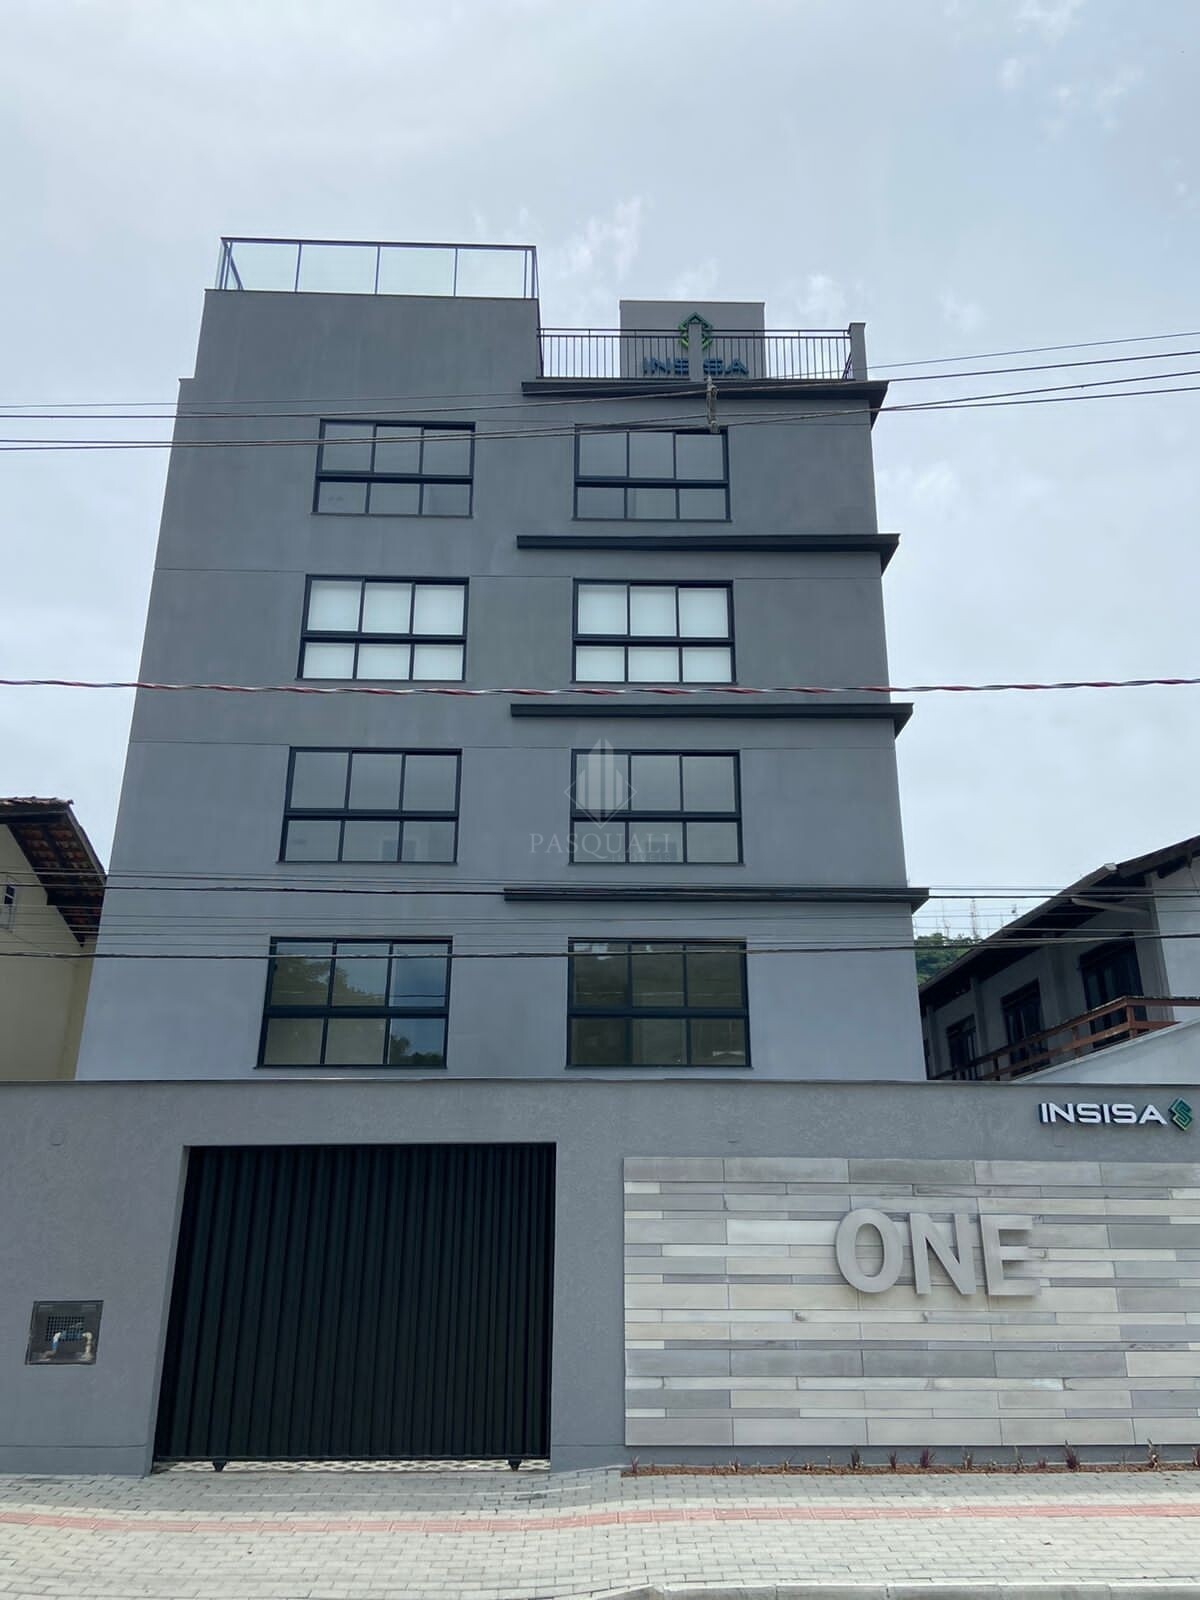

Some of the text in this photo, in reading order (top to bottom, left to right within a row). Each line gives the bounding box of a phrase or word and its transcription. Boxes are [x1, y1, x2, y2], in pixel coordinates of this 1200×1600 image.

[642, 357, 749, 375] INSSA
[1039, 1102, 1168, 1125] INSISA
[836, 1208, 1041, 1296] ONE
